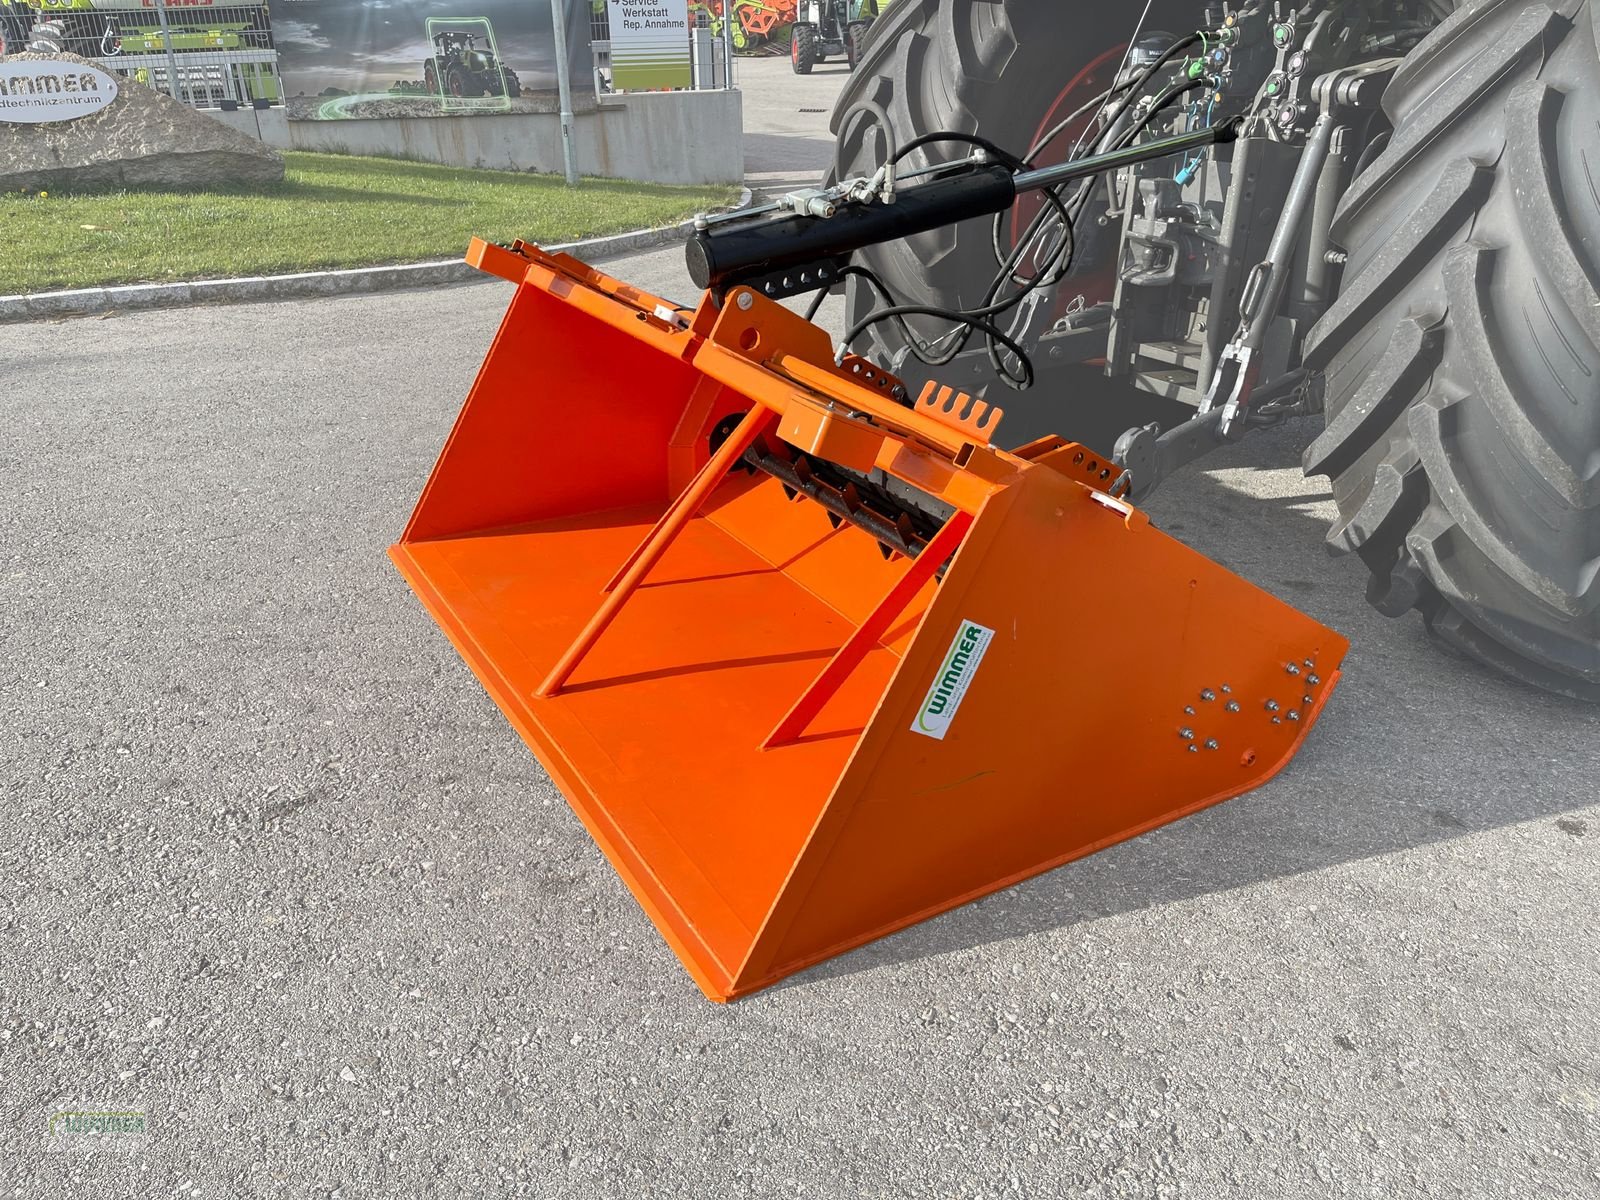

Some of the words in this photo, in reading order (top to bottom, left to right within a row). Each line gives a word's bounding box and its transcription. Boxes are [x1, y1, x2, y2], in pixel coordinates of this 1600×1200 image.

[622, 8, 668, 17] Werkstatt
[623, 20, 643, 31] Rep.
[645, 19, 685, 29] Annahme
[928, 626, 982, 714] WIMMER
